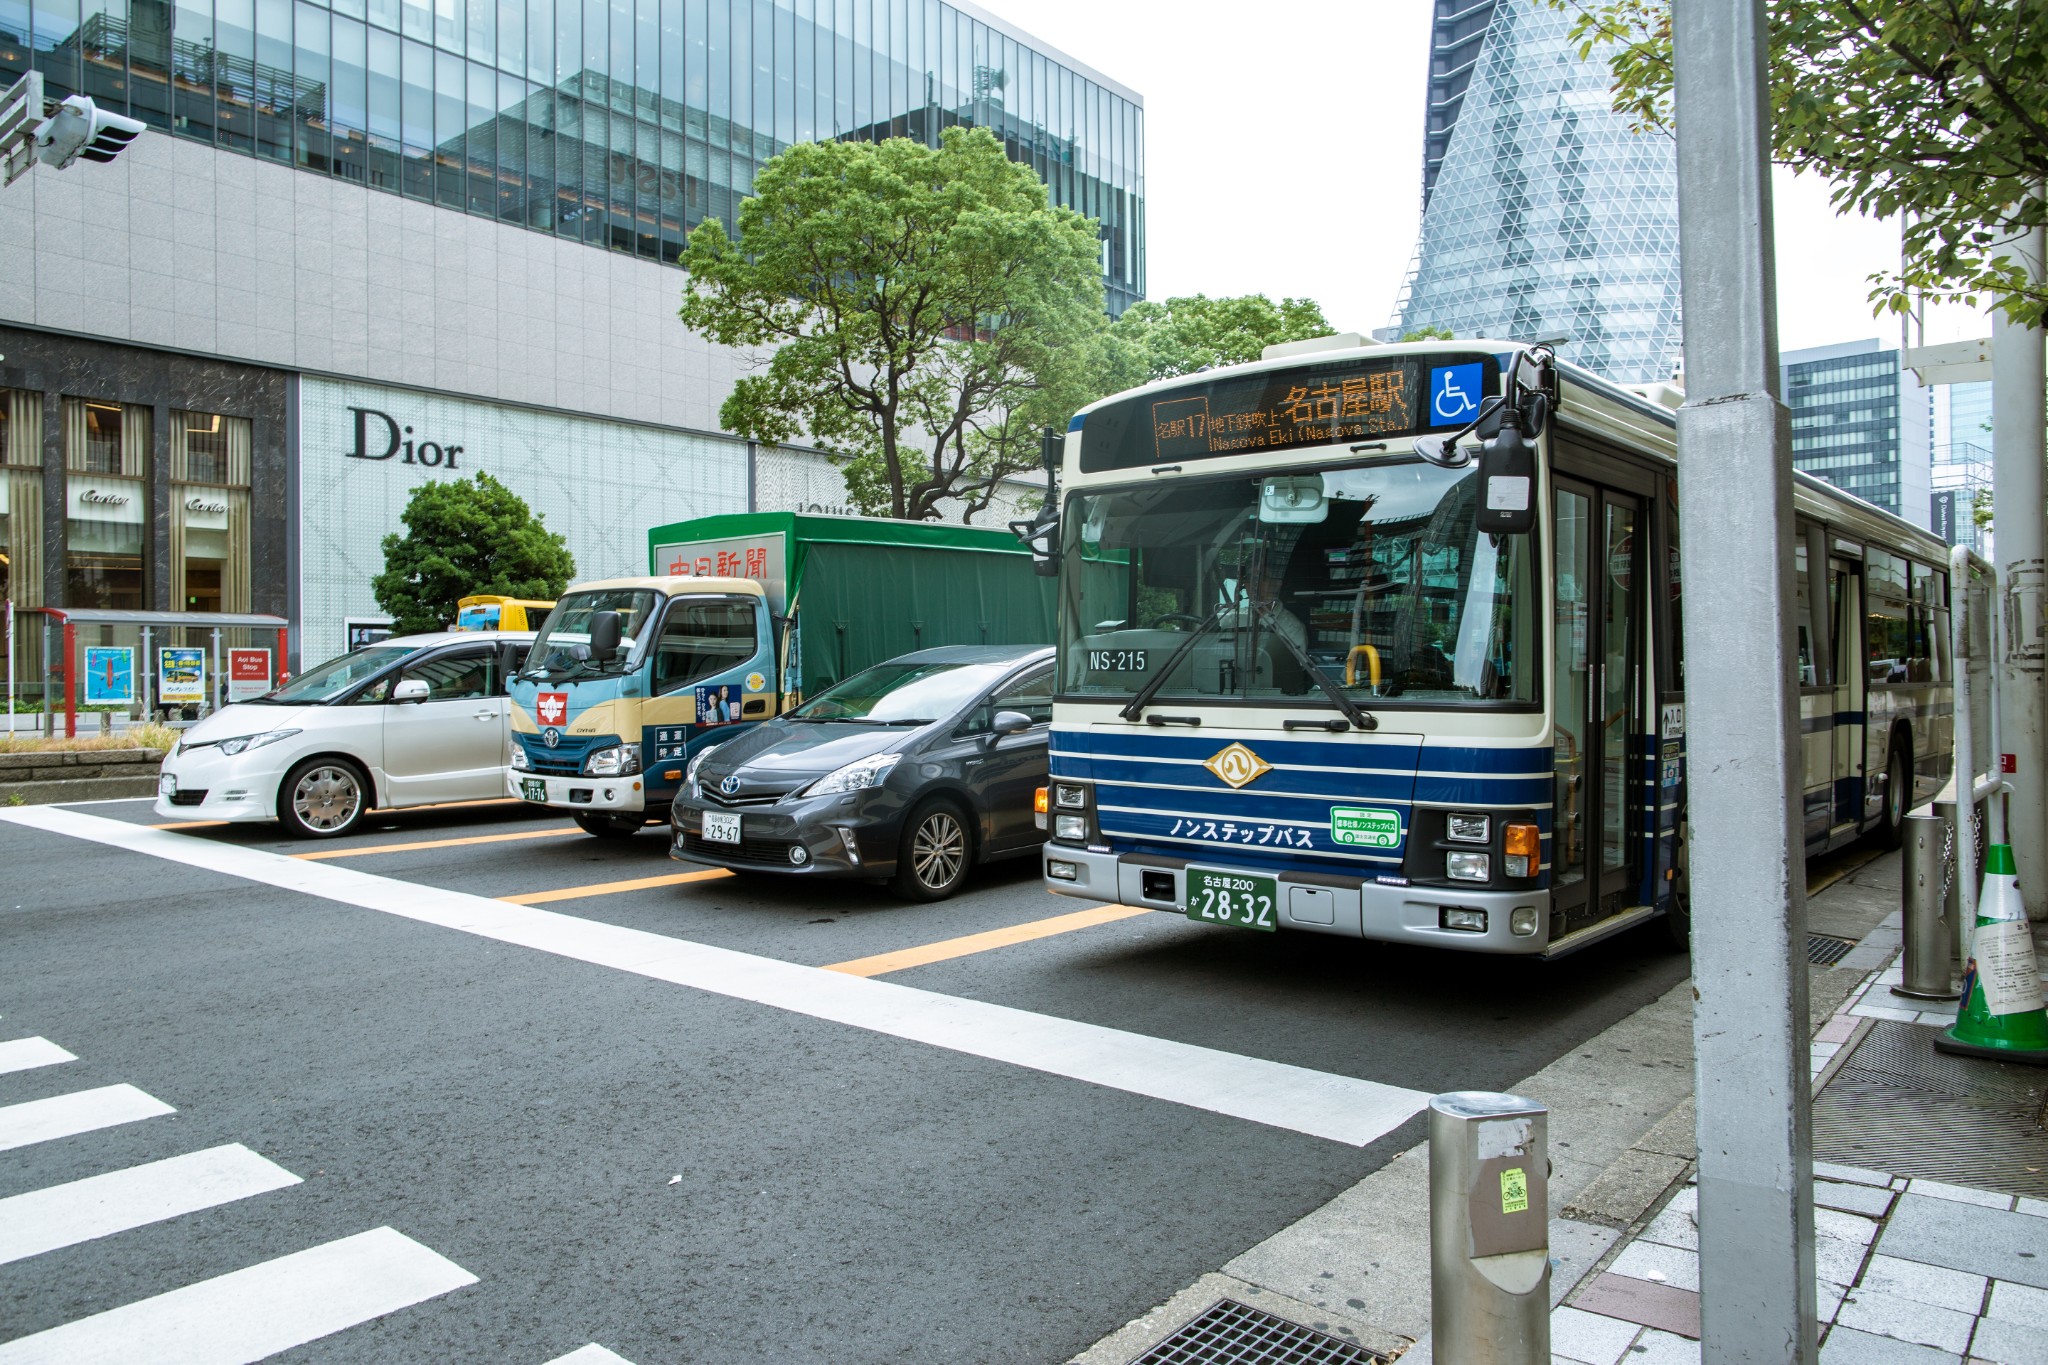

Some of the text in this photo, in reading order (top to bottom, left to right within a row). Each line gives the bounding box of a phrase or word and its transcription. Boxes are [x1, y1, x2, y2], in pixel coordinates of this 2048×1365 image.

[1283, 371, 1408, 424] 名古屋駅
[345, 406, 465, 469] Dior
[1270, 428, 1293, 445] Eki
[80, 489, 129, 505] Cartier
[186, 498, 230, 514] Cartier
[669, 548, 767, 579] 中日新聞
[1090, 651, 1145, 671] NS-215
[659, 747, 682, 758] 特定
[528, 787, 545, 801] 17-76
[711, 824, 739, 842] 29-67
[1169, 818, 1314, 849] ノンステップバス
[1190, 888, 1272, 927] か 28-32
